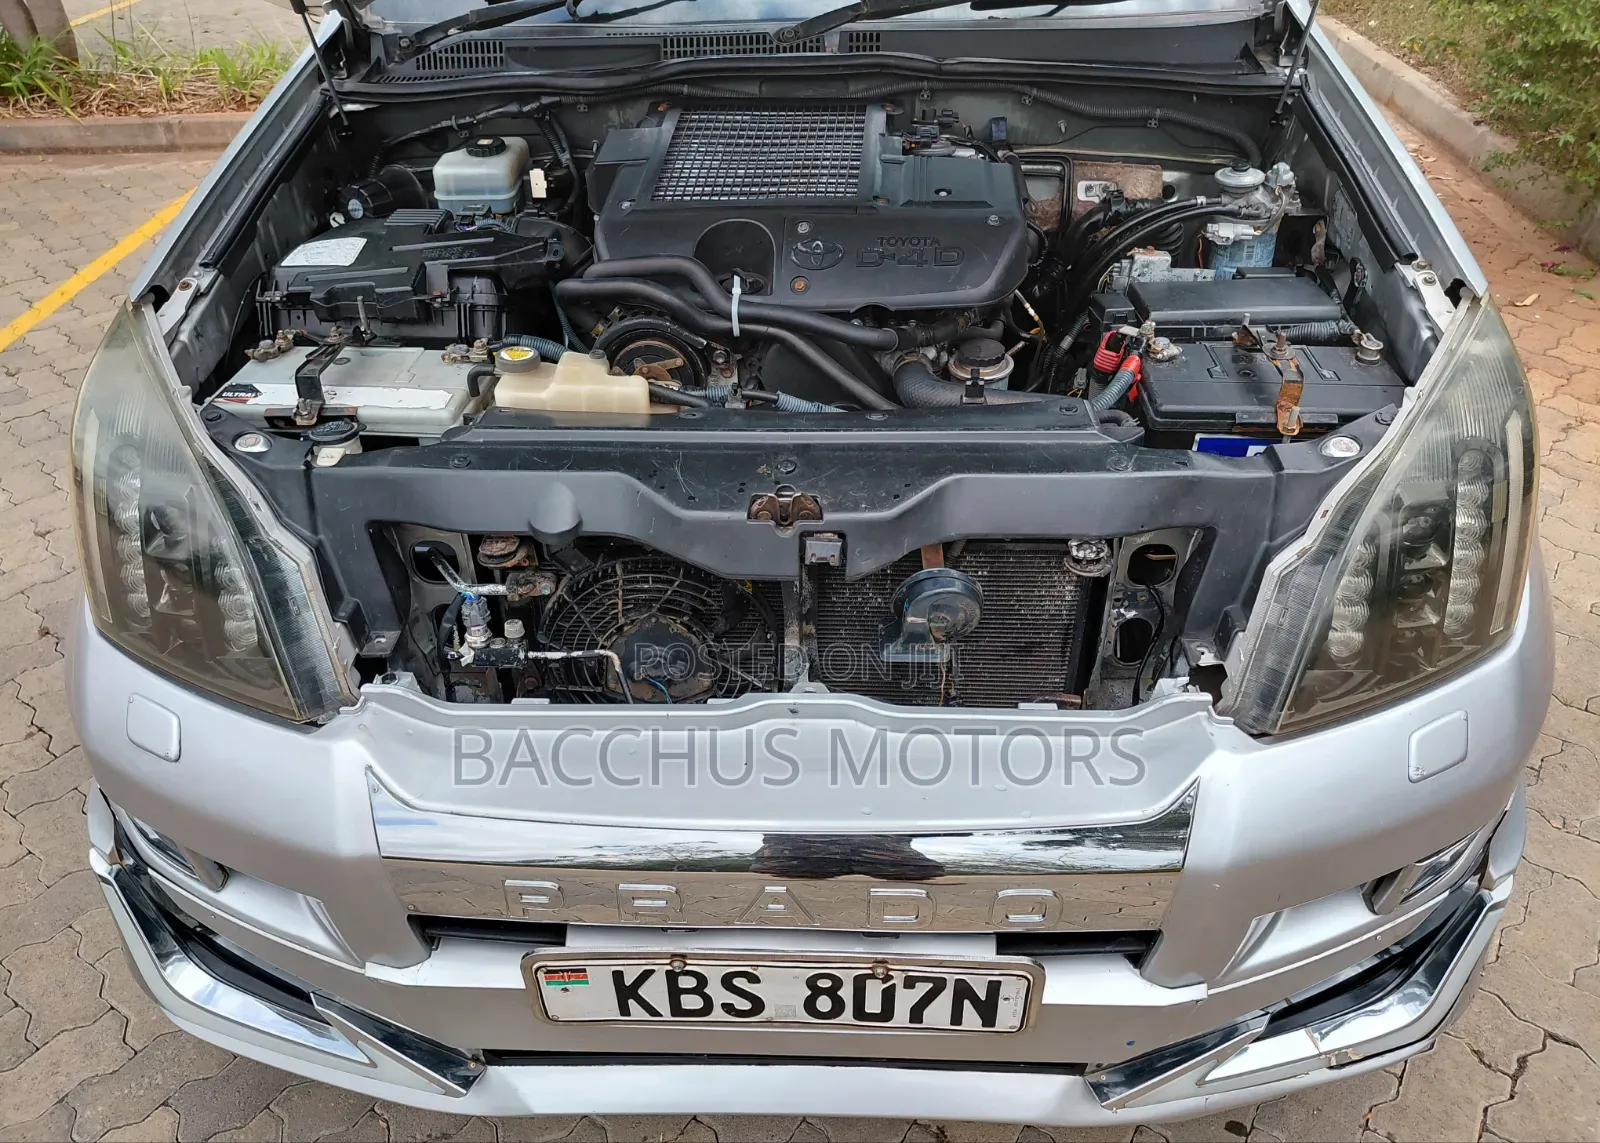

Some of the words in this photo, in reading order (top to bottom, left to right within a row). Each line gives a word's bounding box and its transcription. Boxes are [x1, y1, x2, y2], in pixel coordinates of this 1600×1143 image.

[877, 237, 941, 248] TOYOTA
[502, 879, 1062, 929] PRADO
[611, 969, 766, 1018] KBS
[802, 973, 1002, 1029] 807N
